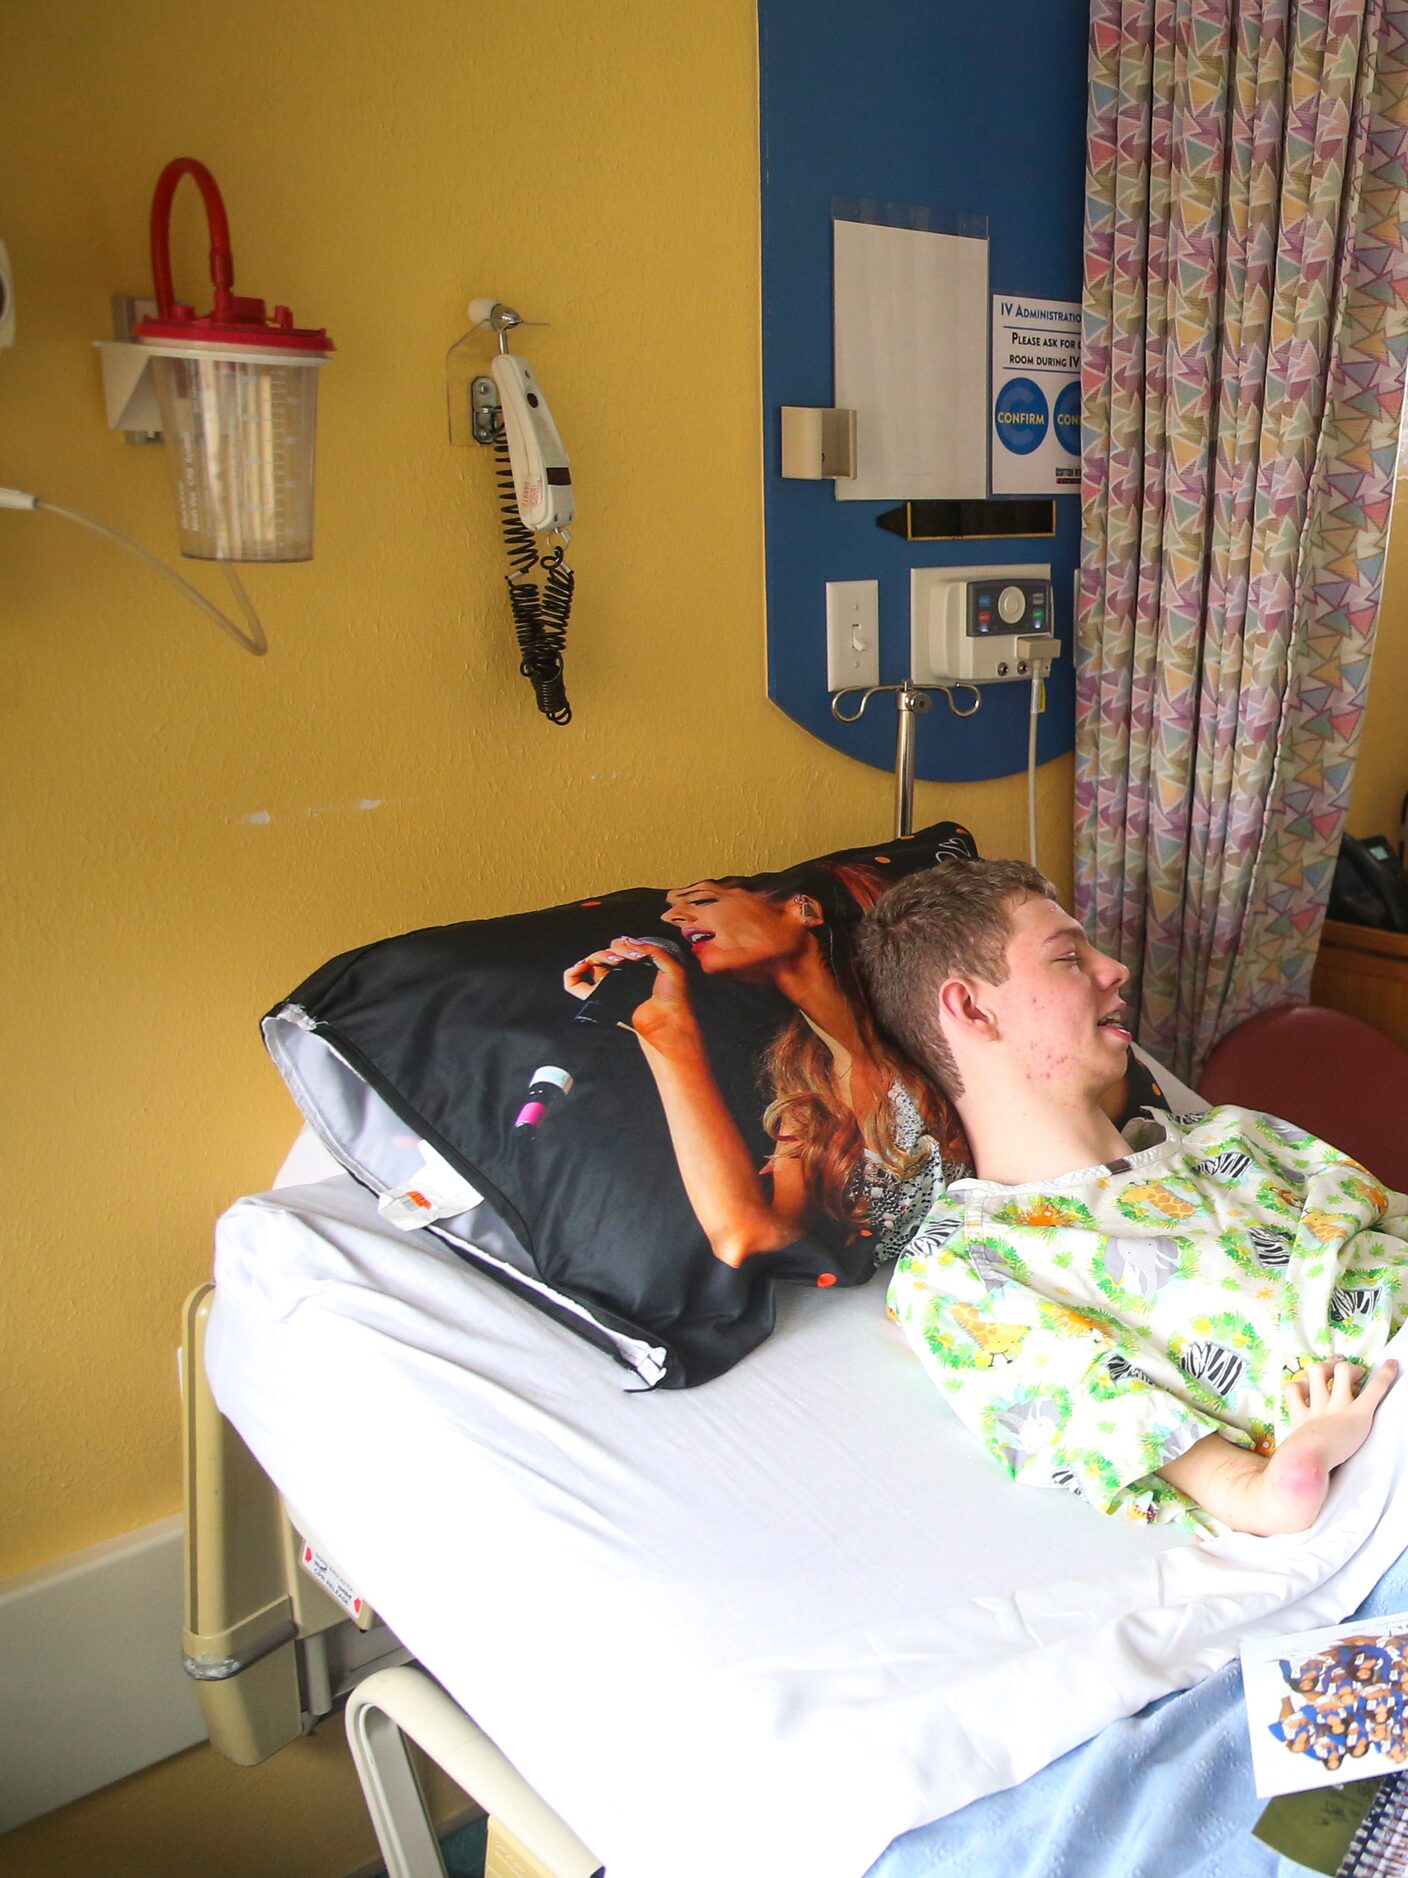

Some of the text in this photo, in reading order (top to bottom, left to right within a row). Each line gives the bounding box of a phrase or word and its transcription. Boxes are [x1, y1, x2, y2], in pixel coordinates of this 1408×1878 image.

[1001, 302, 1082, 323] IV ADMINISTRATIO
[1011, 332, 1041, 346] PLEASE
[1043, 338, 1058, 347] ASK
[1060, 340, 1076, 349] FOR
[1009, 354, 1081, 368] ROOM DURING IV
[997, 411, 1045, 425] CONFIRM
[1056, 414, 1081, 425] CON
